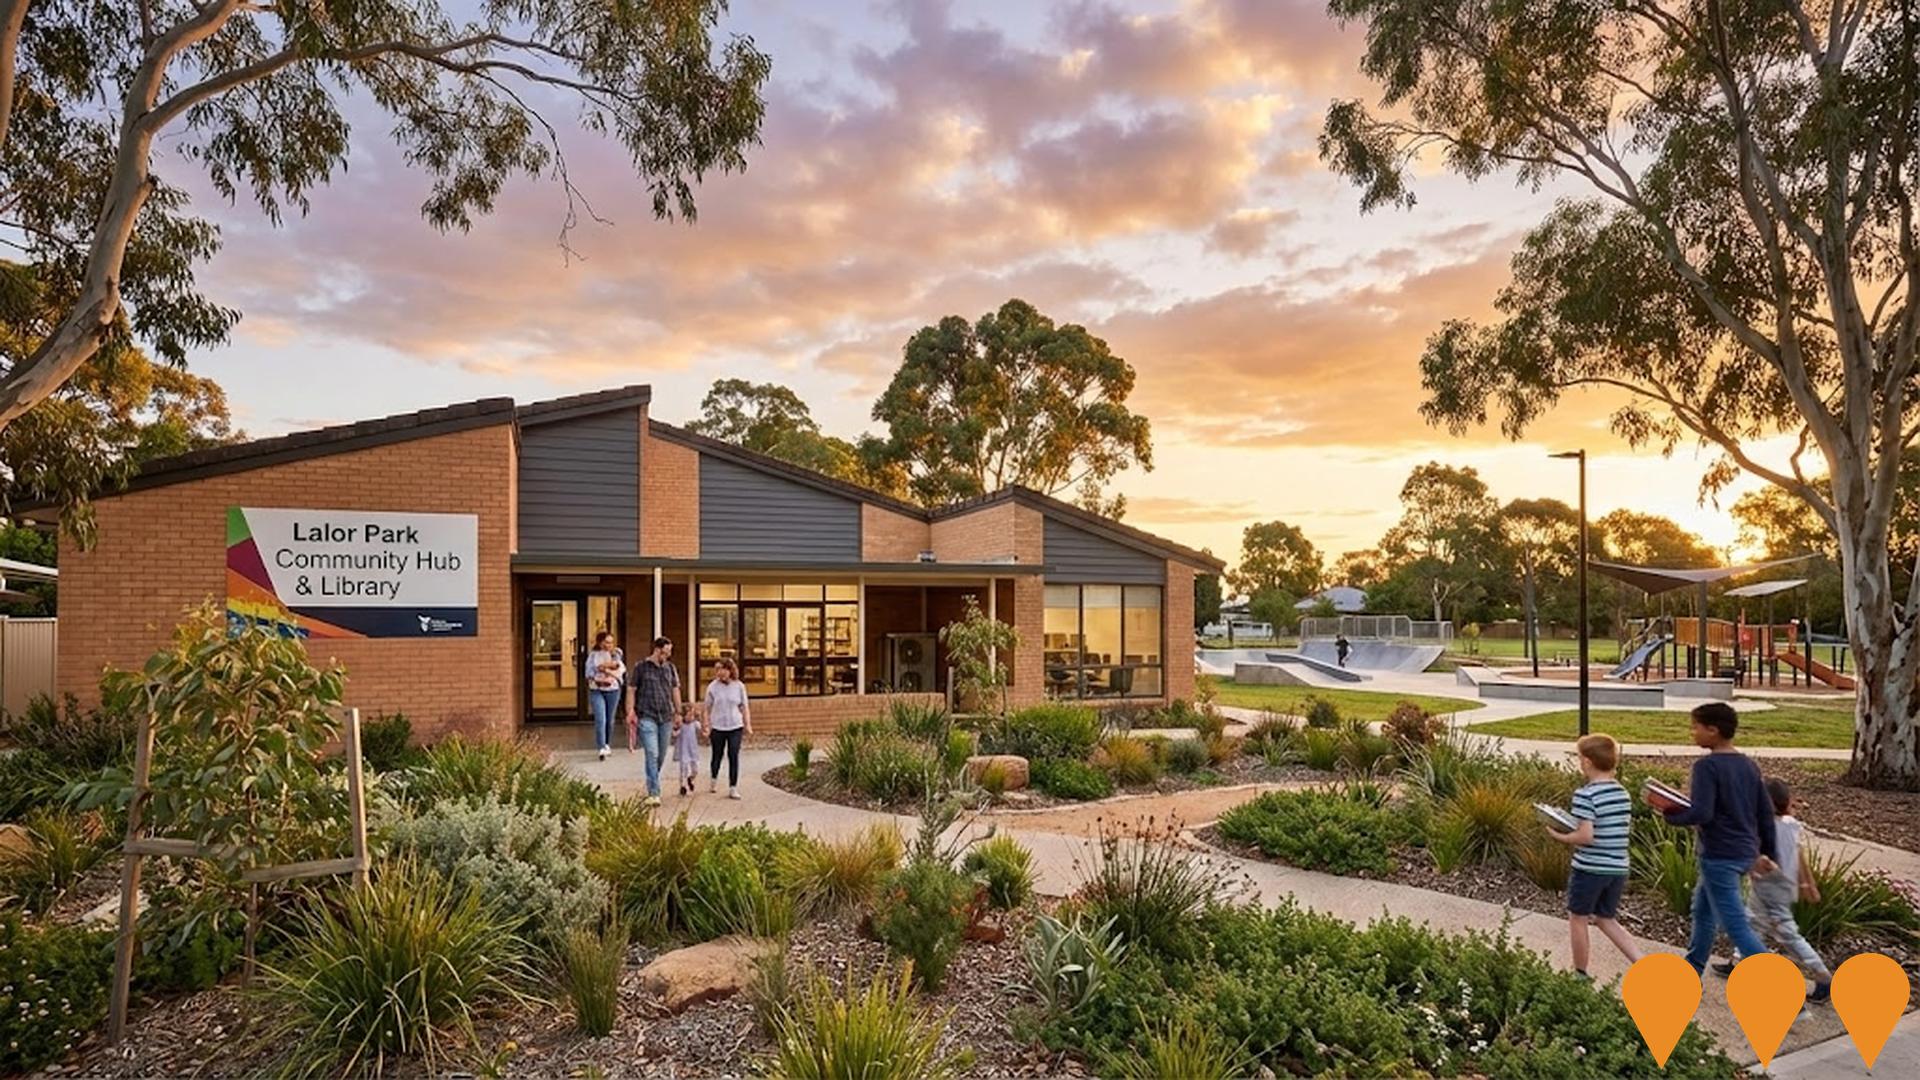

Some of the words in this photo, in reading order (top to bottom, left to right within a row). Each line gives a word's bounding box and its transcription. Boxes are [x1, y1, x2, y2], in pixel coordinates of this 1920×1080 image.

[294, 522, 357, 542] Lalor
[364, 524, 419, 544] Park
[275, 549, 409, 573] Community
[416, 551, 461, 571] Hub
[295, 575, 312, 596] &
[321, 576, 401, 600] Library
